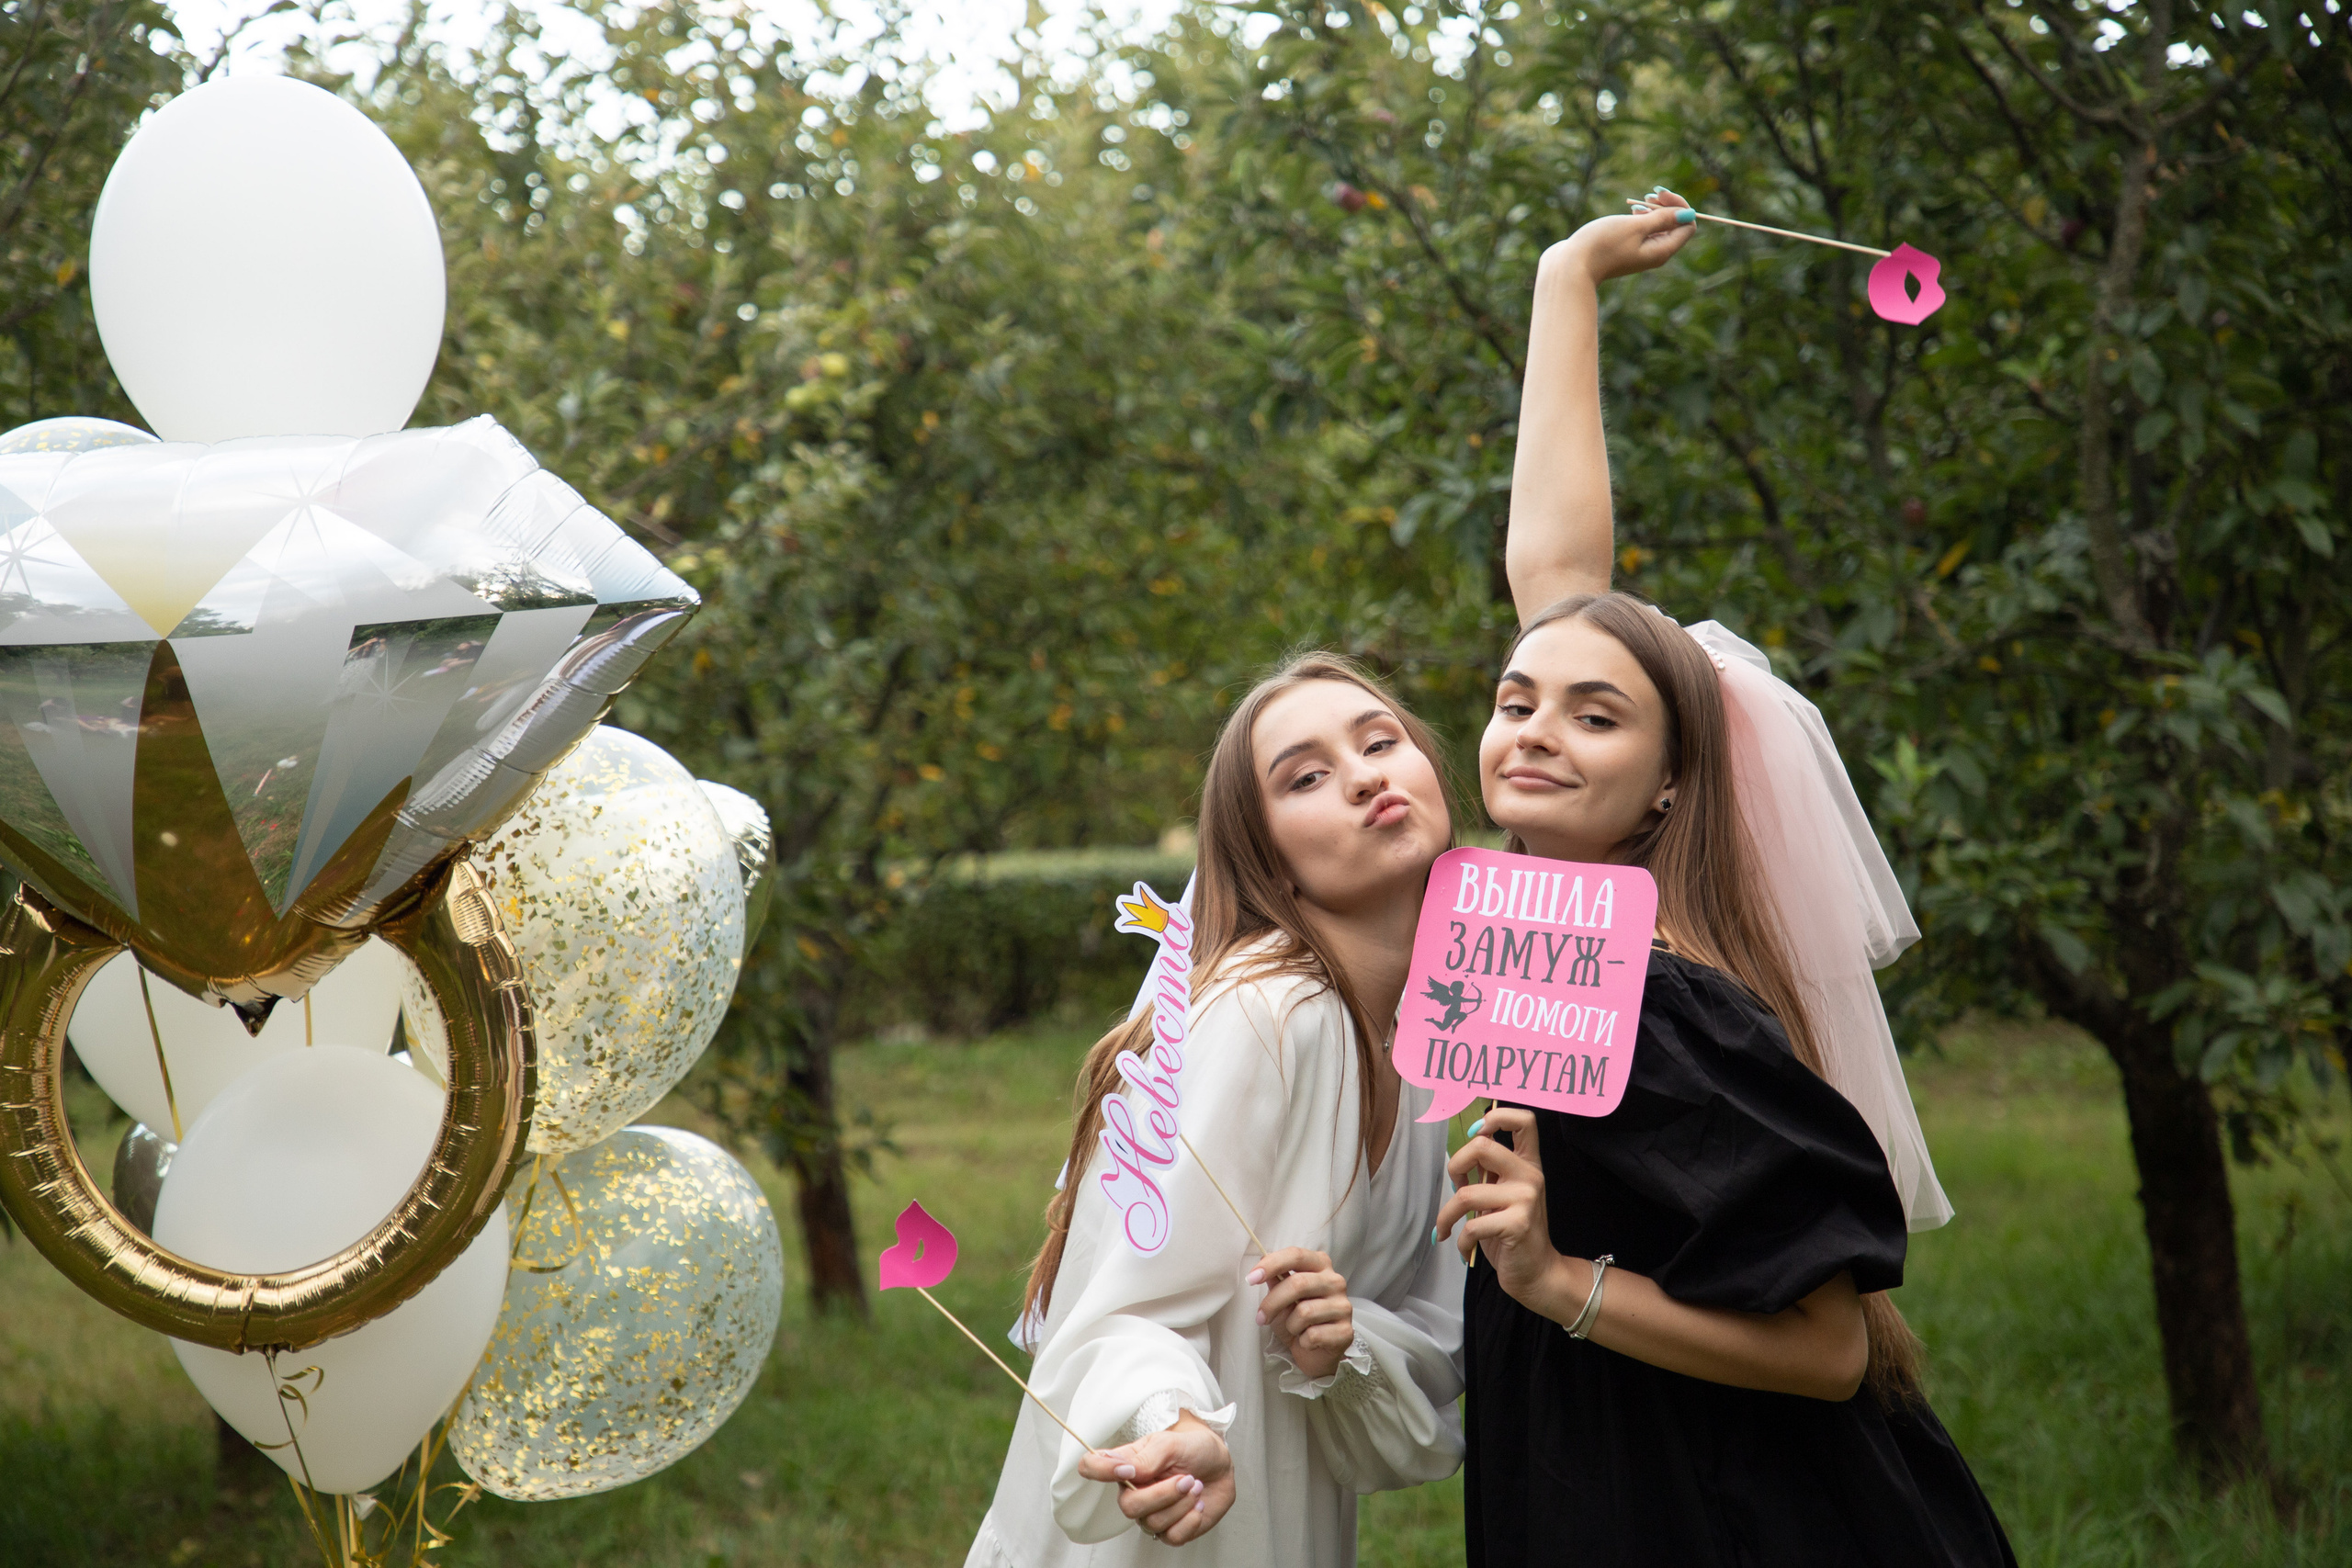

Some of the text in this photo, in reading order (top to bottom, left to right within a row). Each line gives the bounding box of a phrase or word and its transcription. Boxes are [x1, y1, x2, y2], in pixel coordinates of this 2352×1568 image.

[1453, 862, 1614, 929] ВЫШЛА
[1489, 987, 1618, 1046] ПОМОГИ
[1101, 908, 1191, 1252] Невеста
[1422, 1038, 1610, 1097] ПОДРУГАМ
